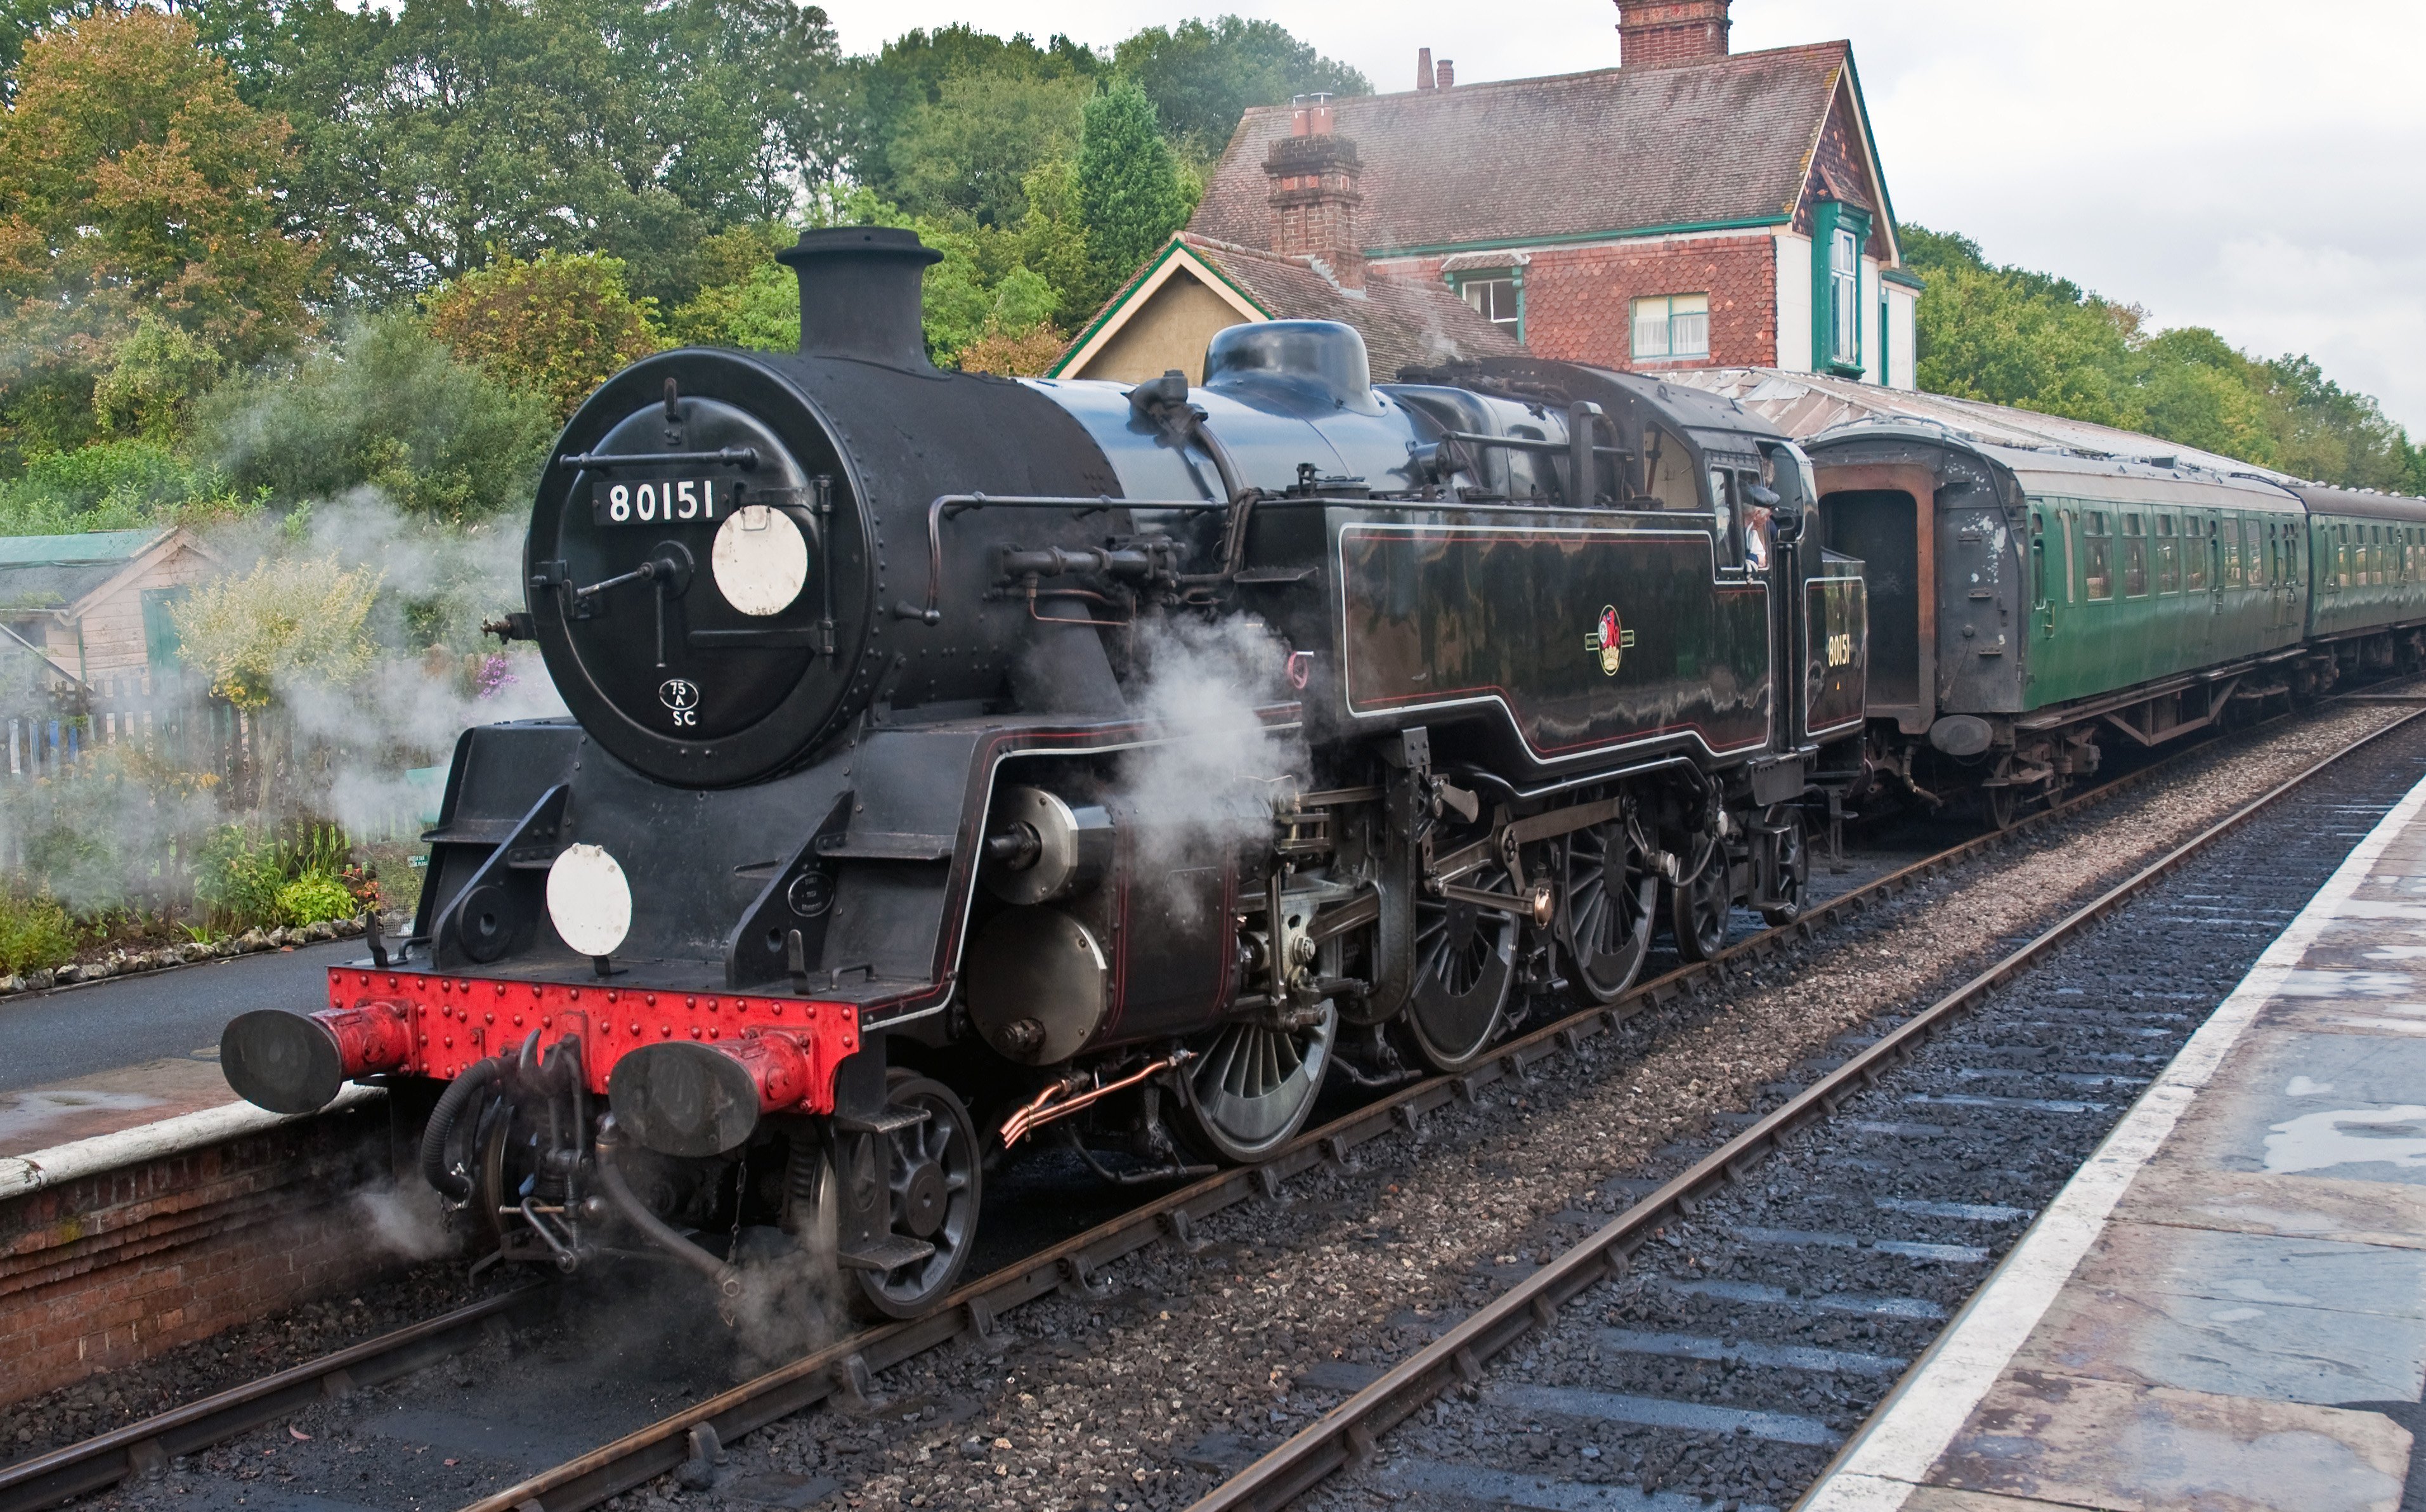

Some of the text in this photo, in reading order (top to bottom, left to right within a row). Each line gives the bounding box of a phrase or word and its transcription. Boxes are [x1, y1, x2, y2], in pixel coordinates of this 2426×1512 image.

[610, 480, 713, 521] 80151
[1829, 634, 1849, 667] 80151
[670, 682, 686, 695] 75
[675, 694, 684, 706] A
[672, 710, 696, 726] SC
